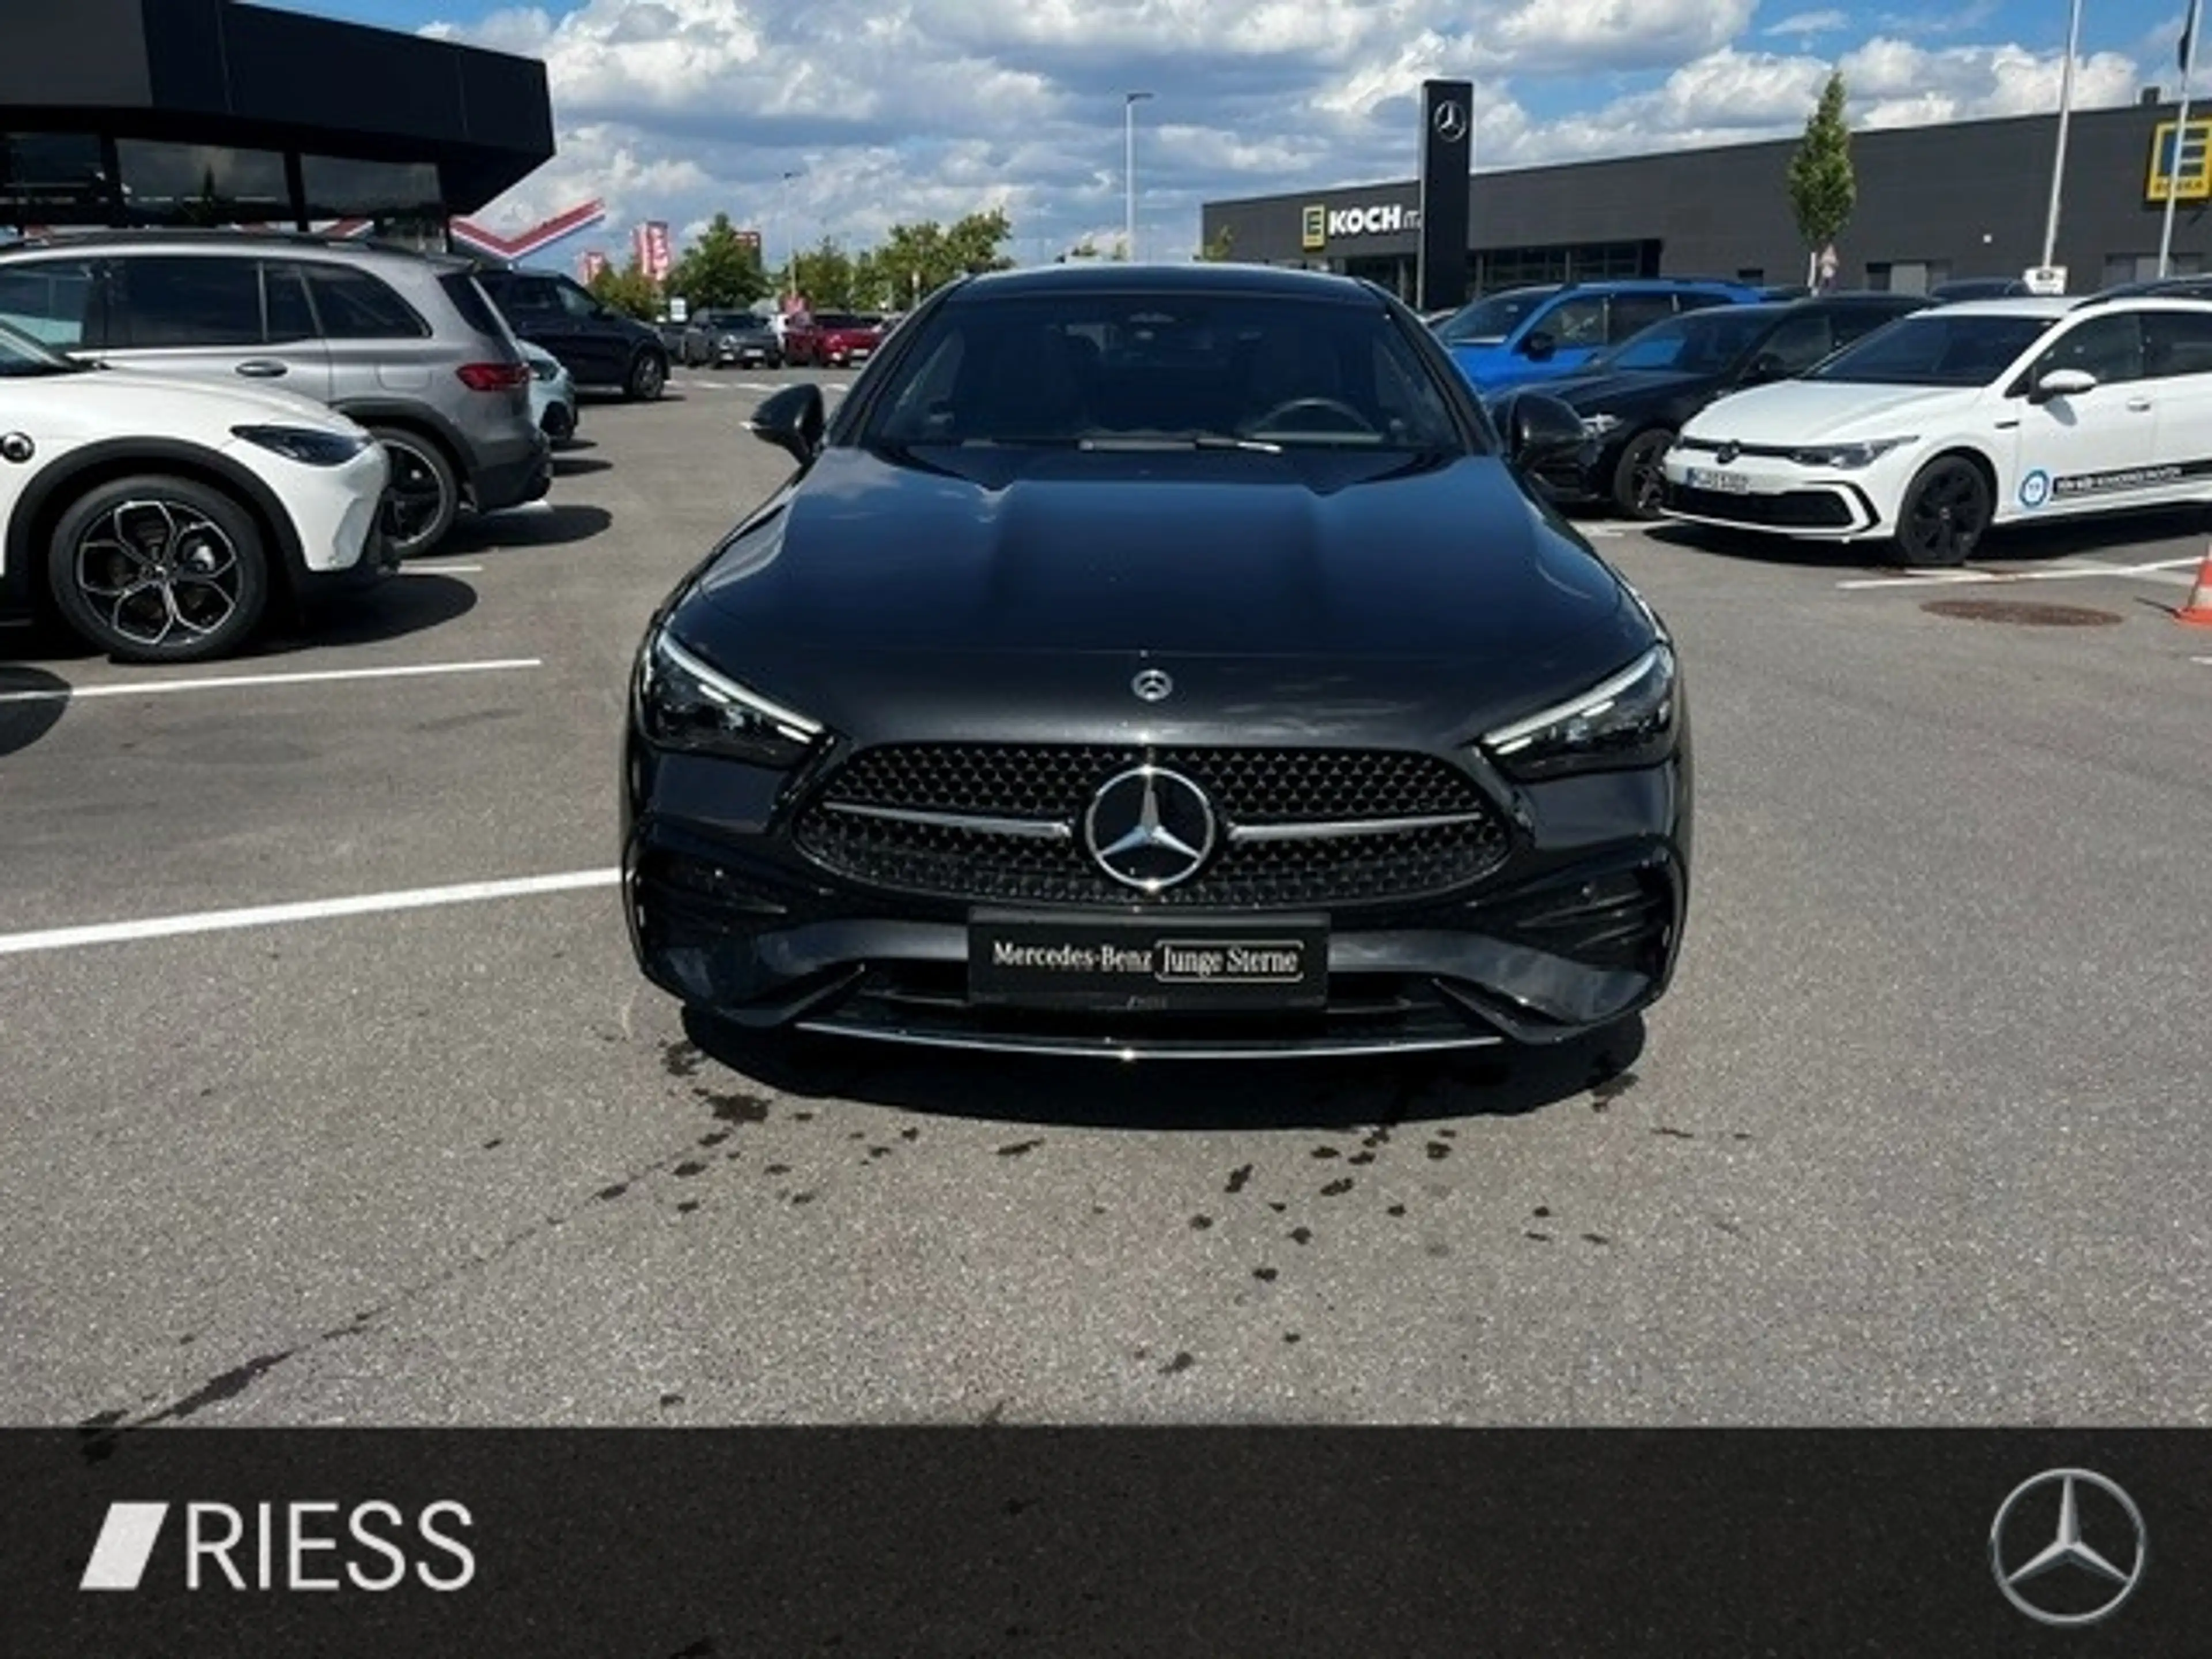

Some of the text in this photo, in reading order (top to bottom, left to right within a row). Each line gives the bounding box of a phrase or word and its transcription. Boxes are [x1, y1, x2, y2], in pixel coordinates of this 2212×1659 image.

[1328, 204, 1401, 235] KOCH
[993, 941, 1298, 977] Mercedes-Benz Junge Sterne
